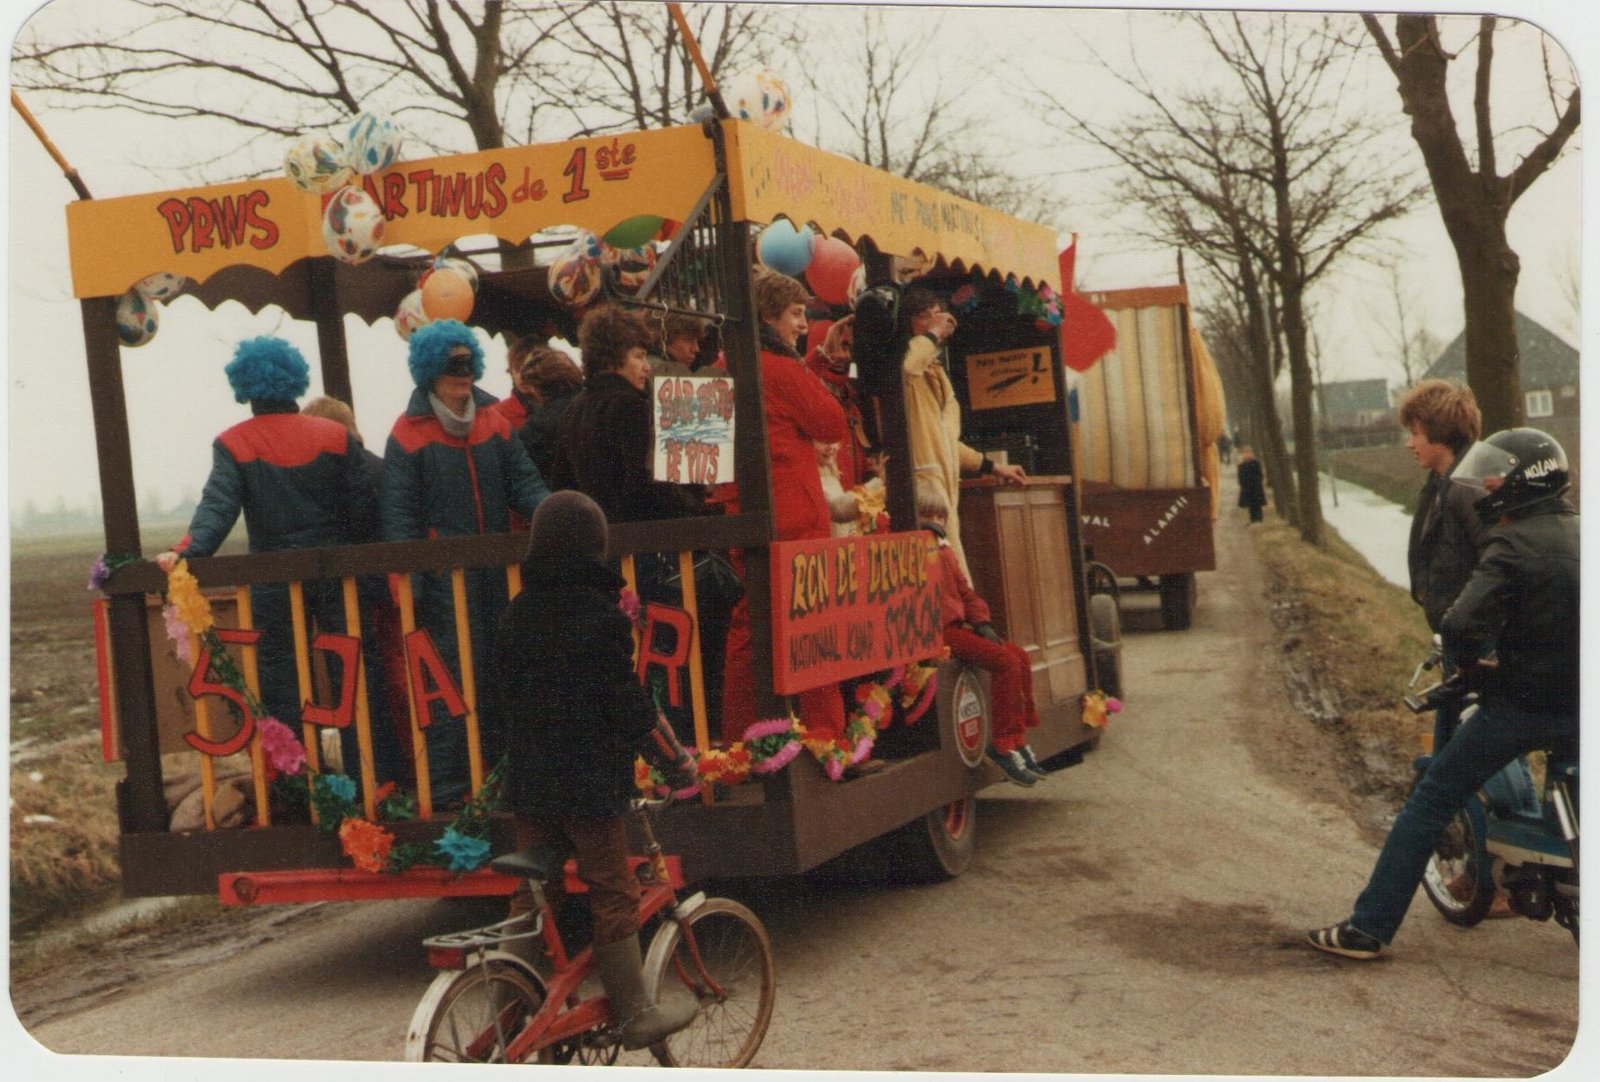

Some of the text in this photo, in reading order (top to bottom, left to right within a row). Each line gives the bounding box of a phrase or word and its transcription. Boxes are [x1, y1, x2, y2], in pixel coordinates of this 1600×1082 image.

[511, 167, 548, 204] de
[1523, 457, 1559, 480] NOLAN
[834, 541, 859, 607] DE
